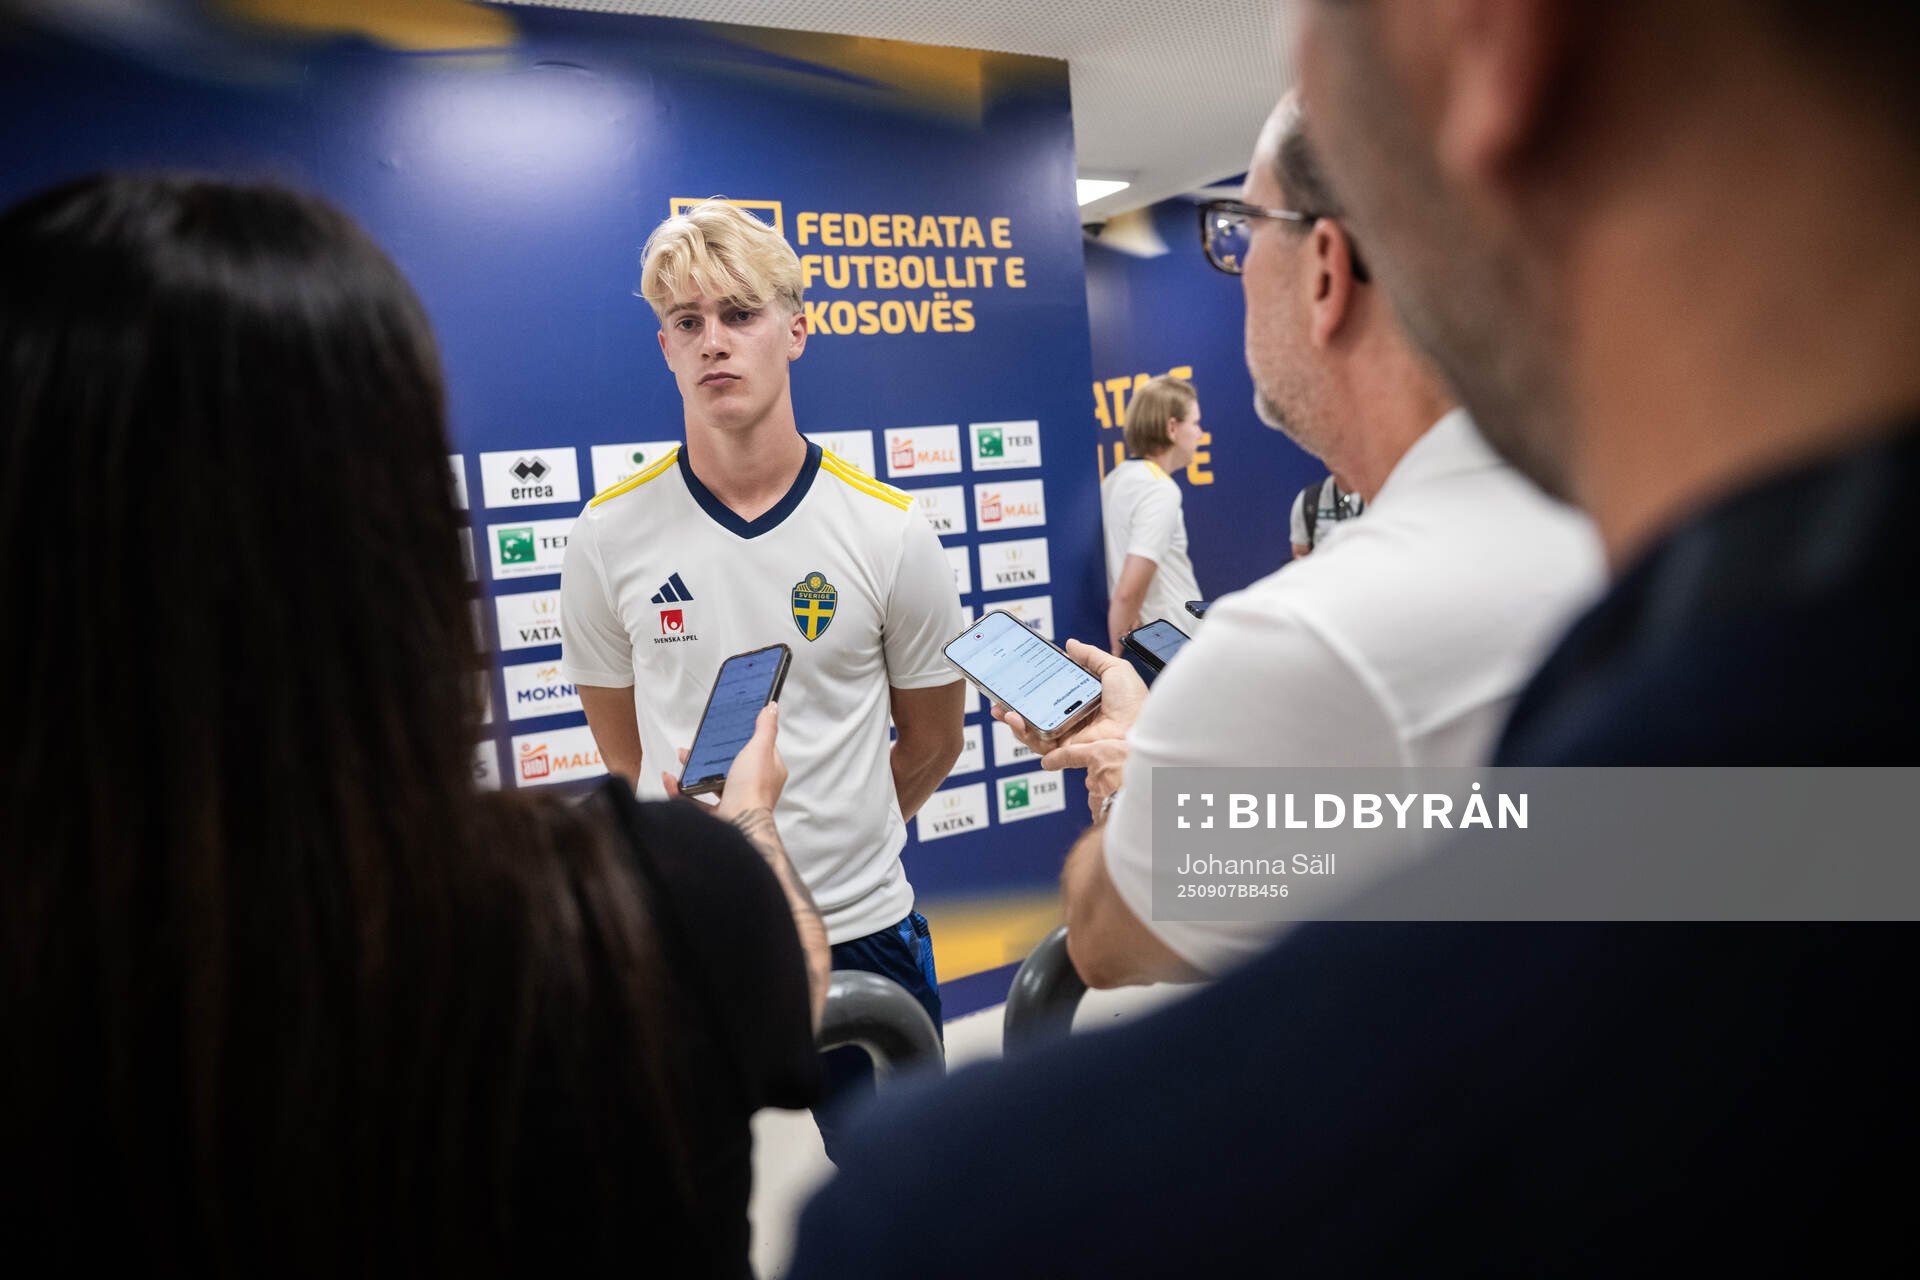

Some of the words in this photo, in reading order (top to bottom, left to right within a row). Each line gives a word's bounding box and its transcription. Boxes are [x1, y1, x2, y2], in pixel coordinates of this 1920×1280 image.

[796, 212, 986, 249] FEDERATA
[990, 217, 1013, 249] E
[801, 254, 998, 289] FUTBOLLIT
[1005, 257, 1027, 289] E
[806, 292, 976, 336] KOSOVËS
[1007, 435, 1033, 447] TEB
[917, 448, 956, 464] MALL
[511, 483, 554, 500] errea
[1004, 503, 1040, 517] MALL
[996, 569, 1037, 583] VATAN
[798, 592, 830, 600] SVERIGE
[654, 636, 681, 644] SVENSKA
[682, 634, 699, 642] SPEL
[1033, 781, 1058, 795] TEB
[933, 815, 975, 834] VATAN
